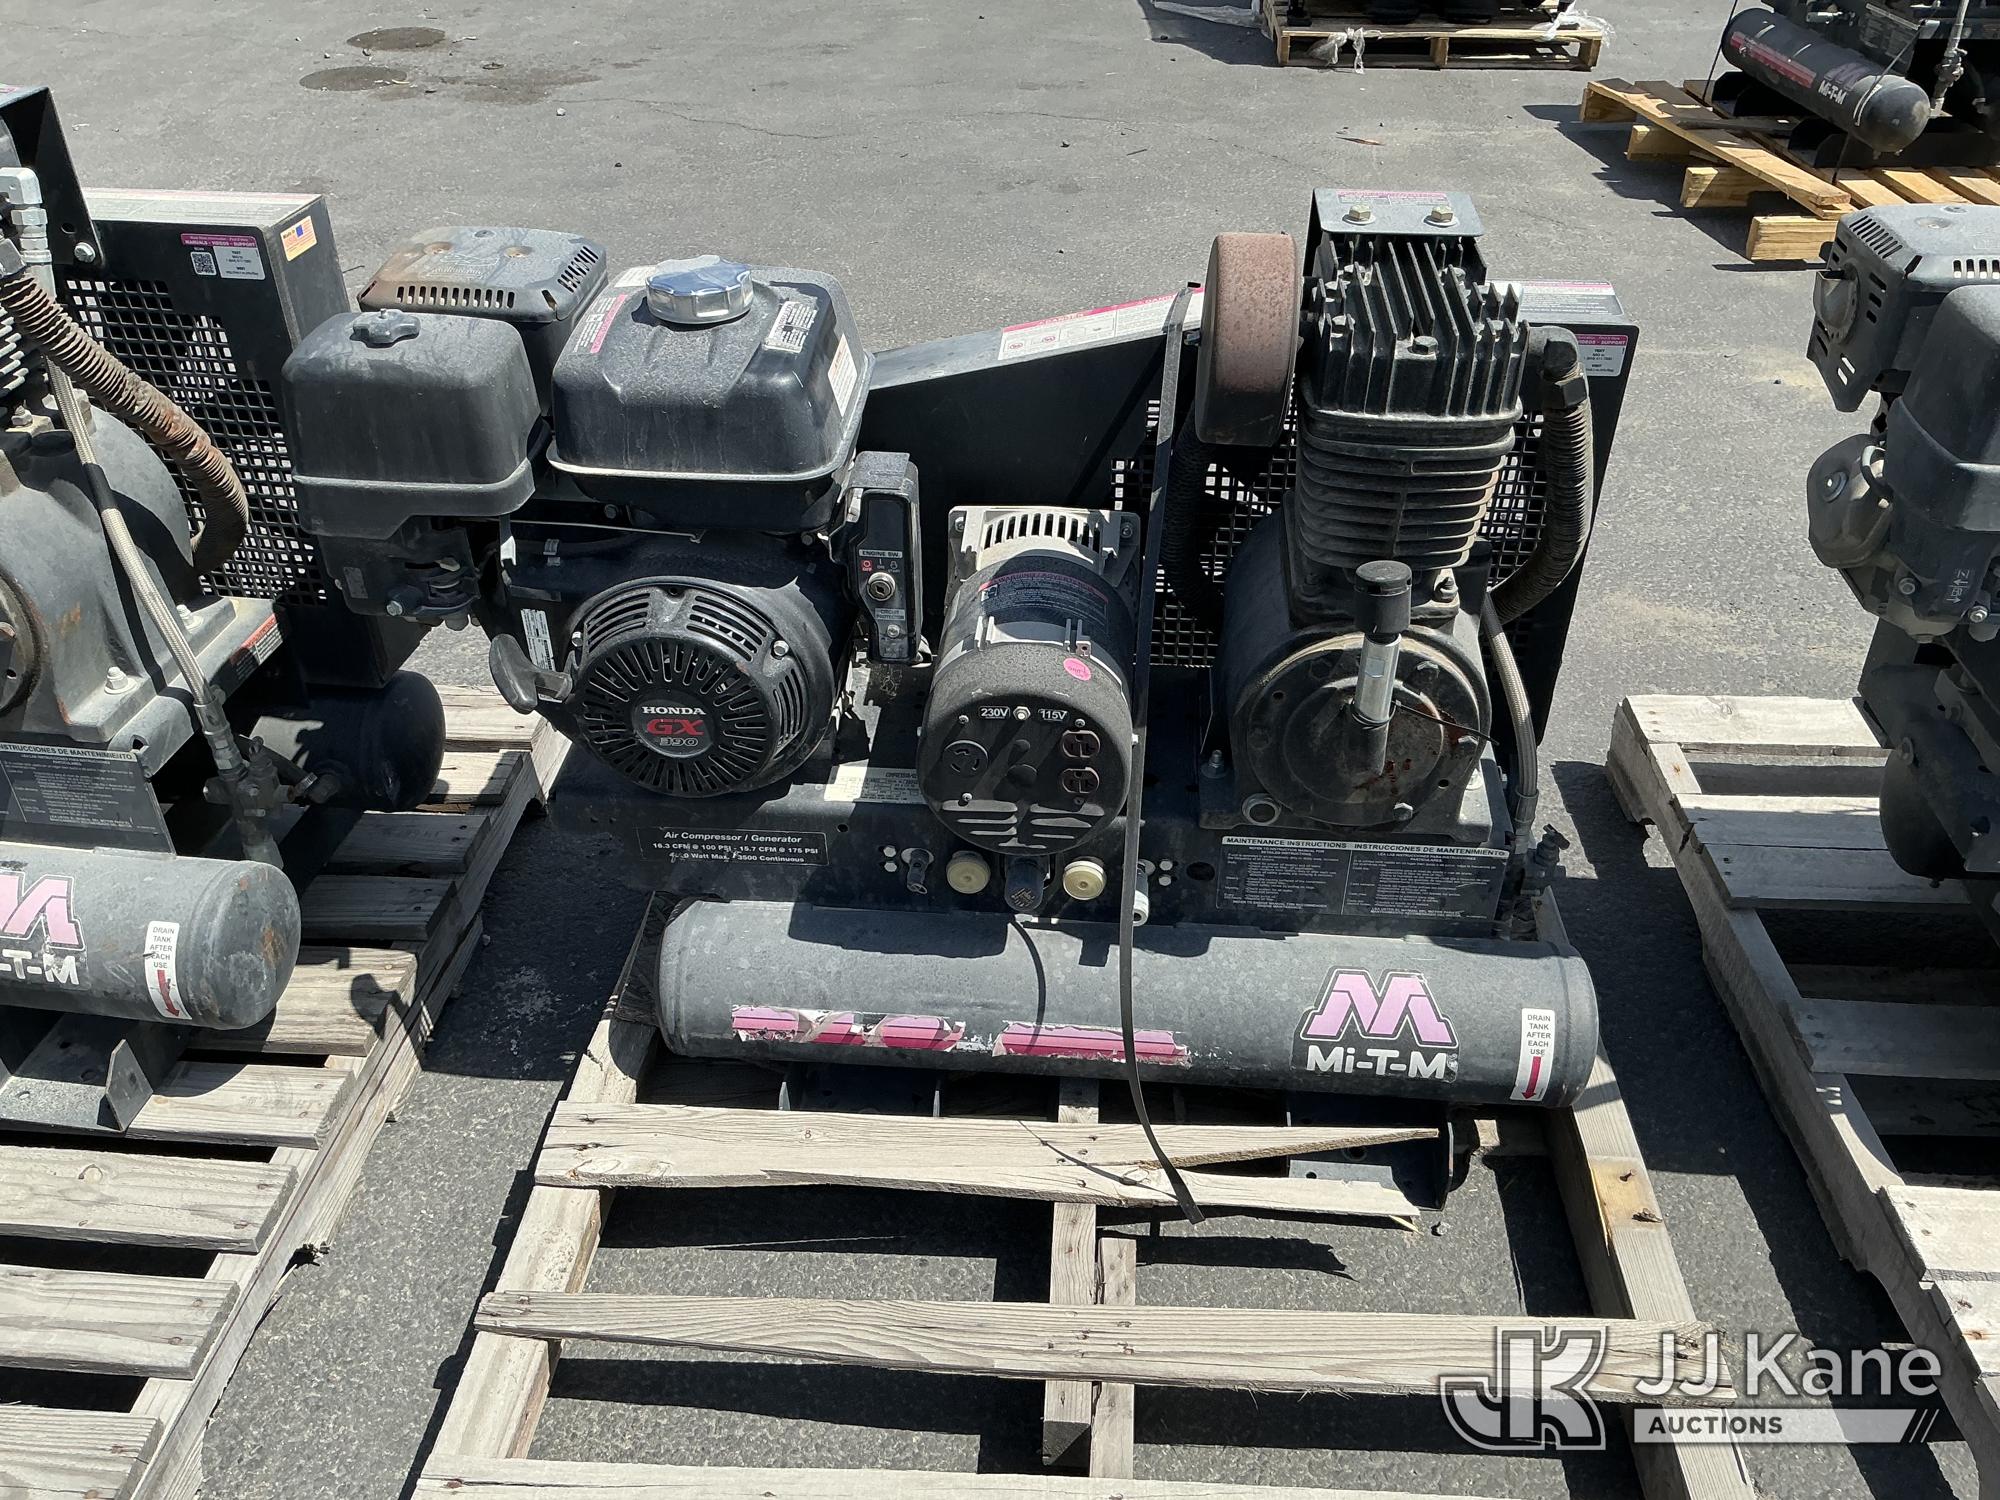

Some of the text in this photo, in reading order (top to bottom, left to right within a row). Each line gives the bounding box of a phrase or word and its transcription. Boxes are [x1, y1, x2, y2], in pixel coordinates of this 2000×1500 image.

[641, 706, 706, 715] HONDA
[980, 708, 1009, 718] 230V
[1040, 710, 1068, 720] 115V
[646, 719, 704, 736] GX
[660, 736, 699, 747] 390
[70, 749, 133, 760] MANTENIMIENTO
[681, 832, 742, 841] Compressor
[751, 834, 802, 843] Generator
[1226, 837, 1347, 849] MAINTENANCE INSTRUCTIONS
[1354, 844, 1421, 852] INSTRUCCIONES
[1436, 847, 1505, 856] MANTENIMIENTO
[759, 855, 805, 863] Continuous
[152, 926, 175, 934] DRAIN
[153, 935, 172, 943] TANK
[150, 944, 173, 952] AFTER
[153, 961, 168, 969] USE
[1527, 1014, 1551, 1022] DRAIN
[1530, 1023, 1549, 1031] TANK
[1526, 1032, 1551, 1040] AFTER
[1528, 1040, 1549, 1048] EACH
[1530, 1049, 1545, 1057] USE
[1306, 1045, 1446, 1080] Mi-T-M
